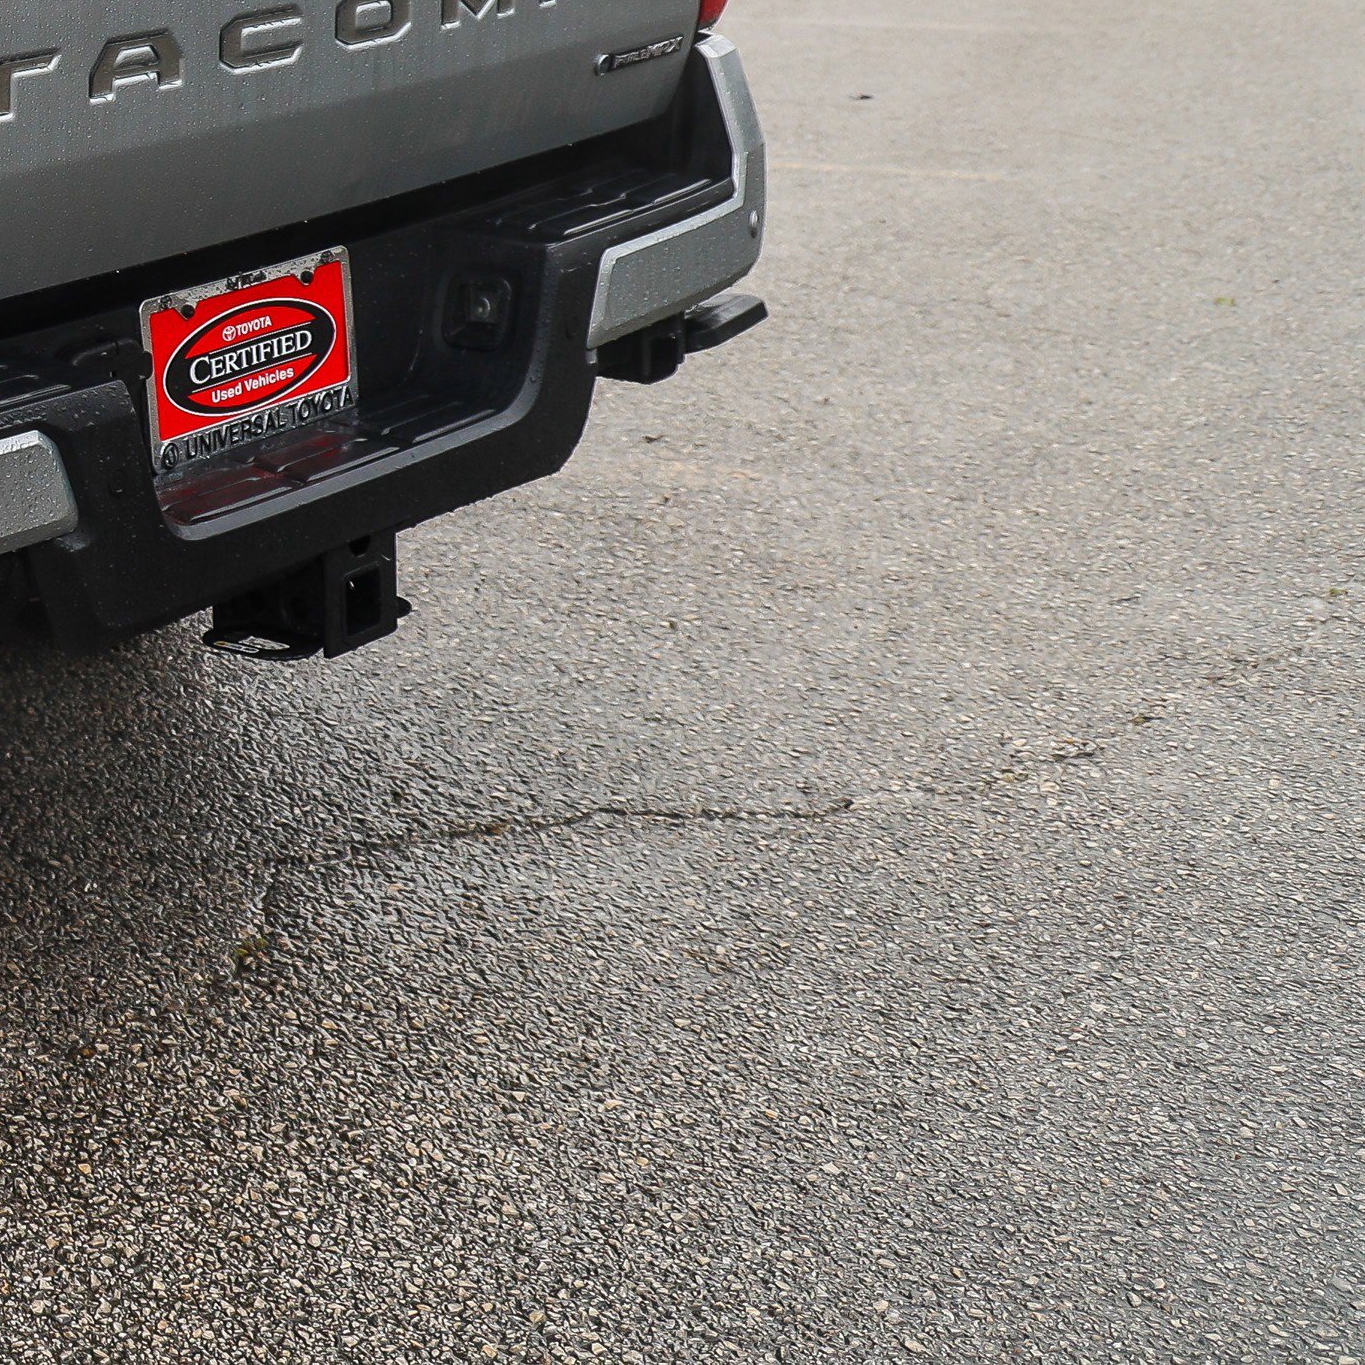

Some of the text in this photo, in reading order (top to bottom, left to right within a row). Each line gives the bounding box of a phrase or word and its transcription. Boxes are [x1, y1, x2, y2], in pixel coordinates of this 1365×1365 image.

[236, 315, 273, 336] TOYOTA
[189, 329, 313, 385] CERTIFIED
[211, 367, 295, 404] Used Vehicles
[185, 408, 287, 459] UNIVERSAL
[287, 385, 354, 425] TOYOTA
